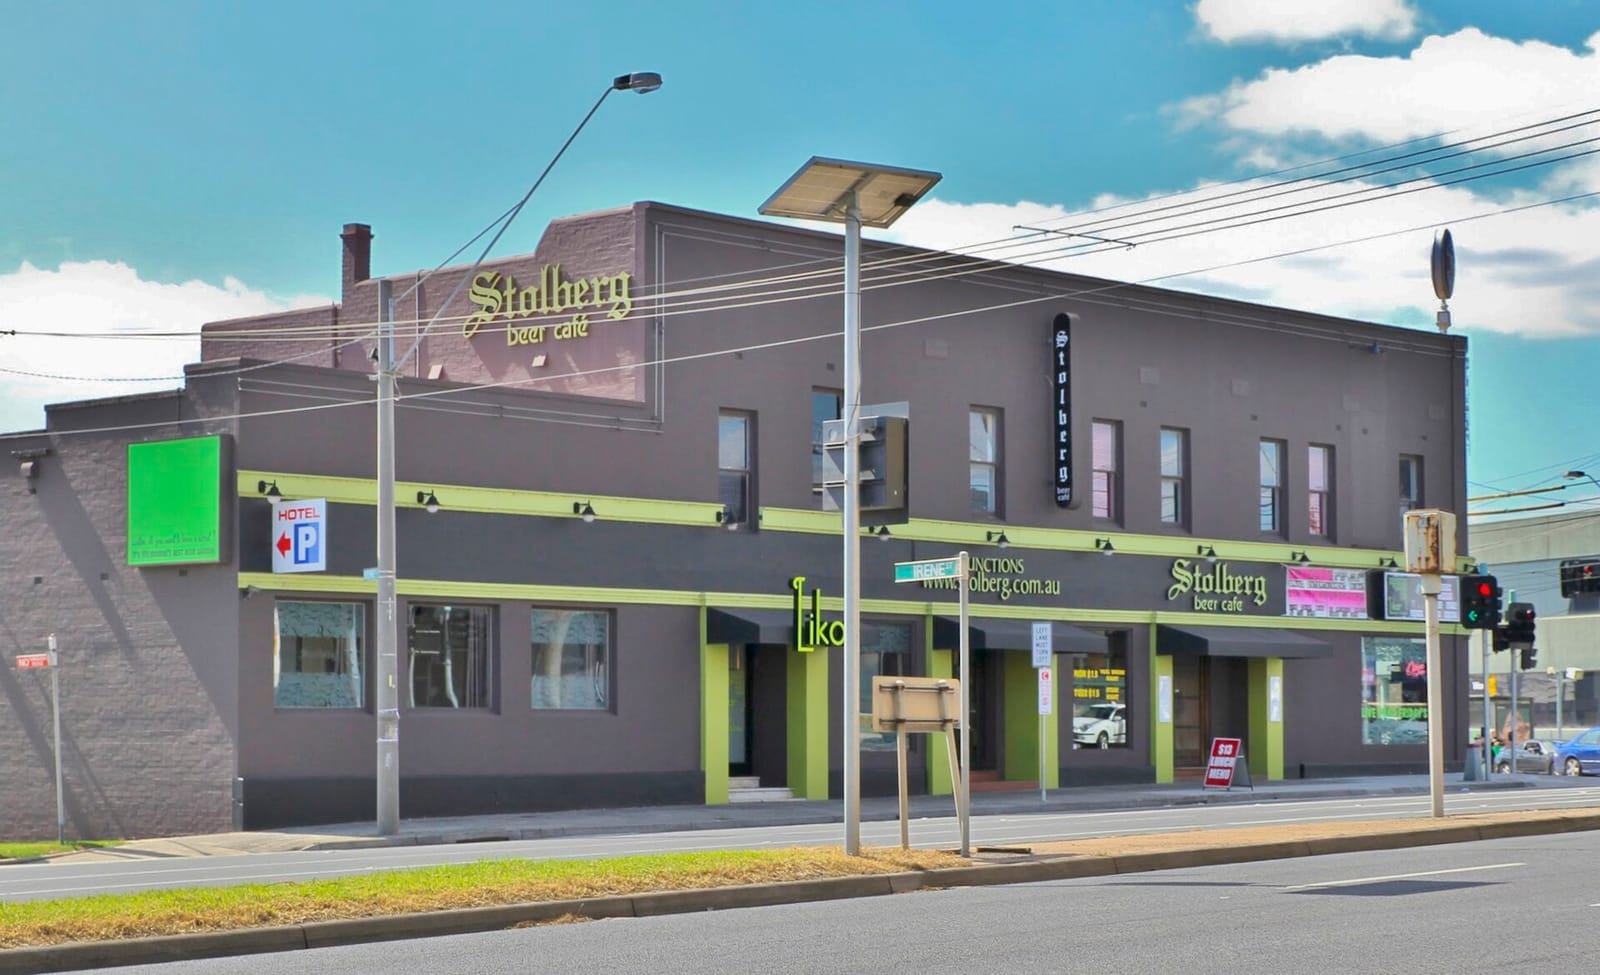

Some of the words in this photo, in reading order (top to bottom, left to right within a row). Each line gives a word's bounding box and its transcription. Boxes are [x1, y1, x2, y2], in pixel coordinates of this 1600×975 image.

[462, 263, 632, 338] Stolberg
[507, 323, 545, 346] beer
[1055, 330, 1069, 483] Stolberg
[278, 506, 321, 521] HOTEL
[297, 526, 317, 561] P
[913, 564, 945, 578] IRENE
[967, 558, 1024, 574] UNCTIONS
[923, 571, 1061, 600] www.olberg.com.au
[1168, 559, 1267, 606] Stolberg
[1194, 595, 1217, 610] beer
